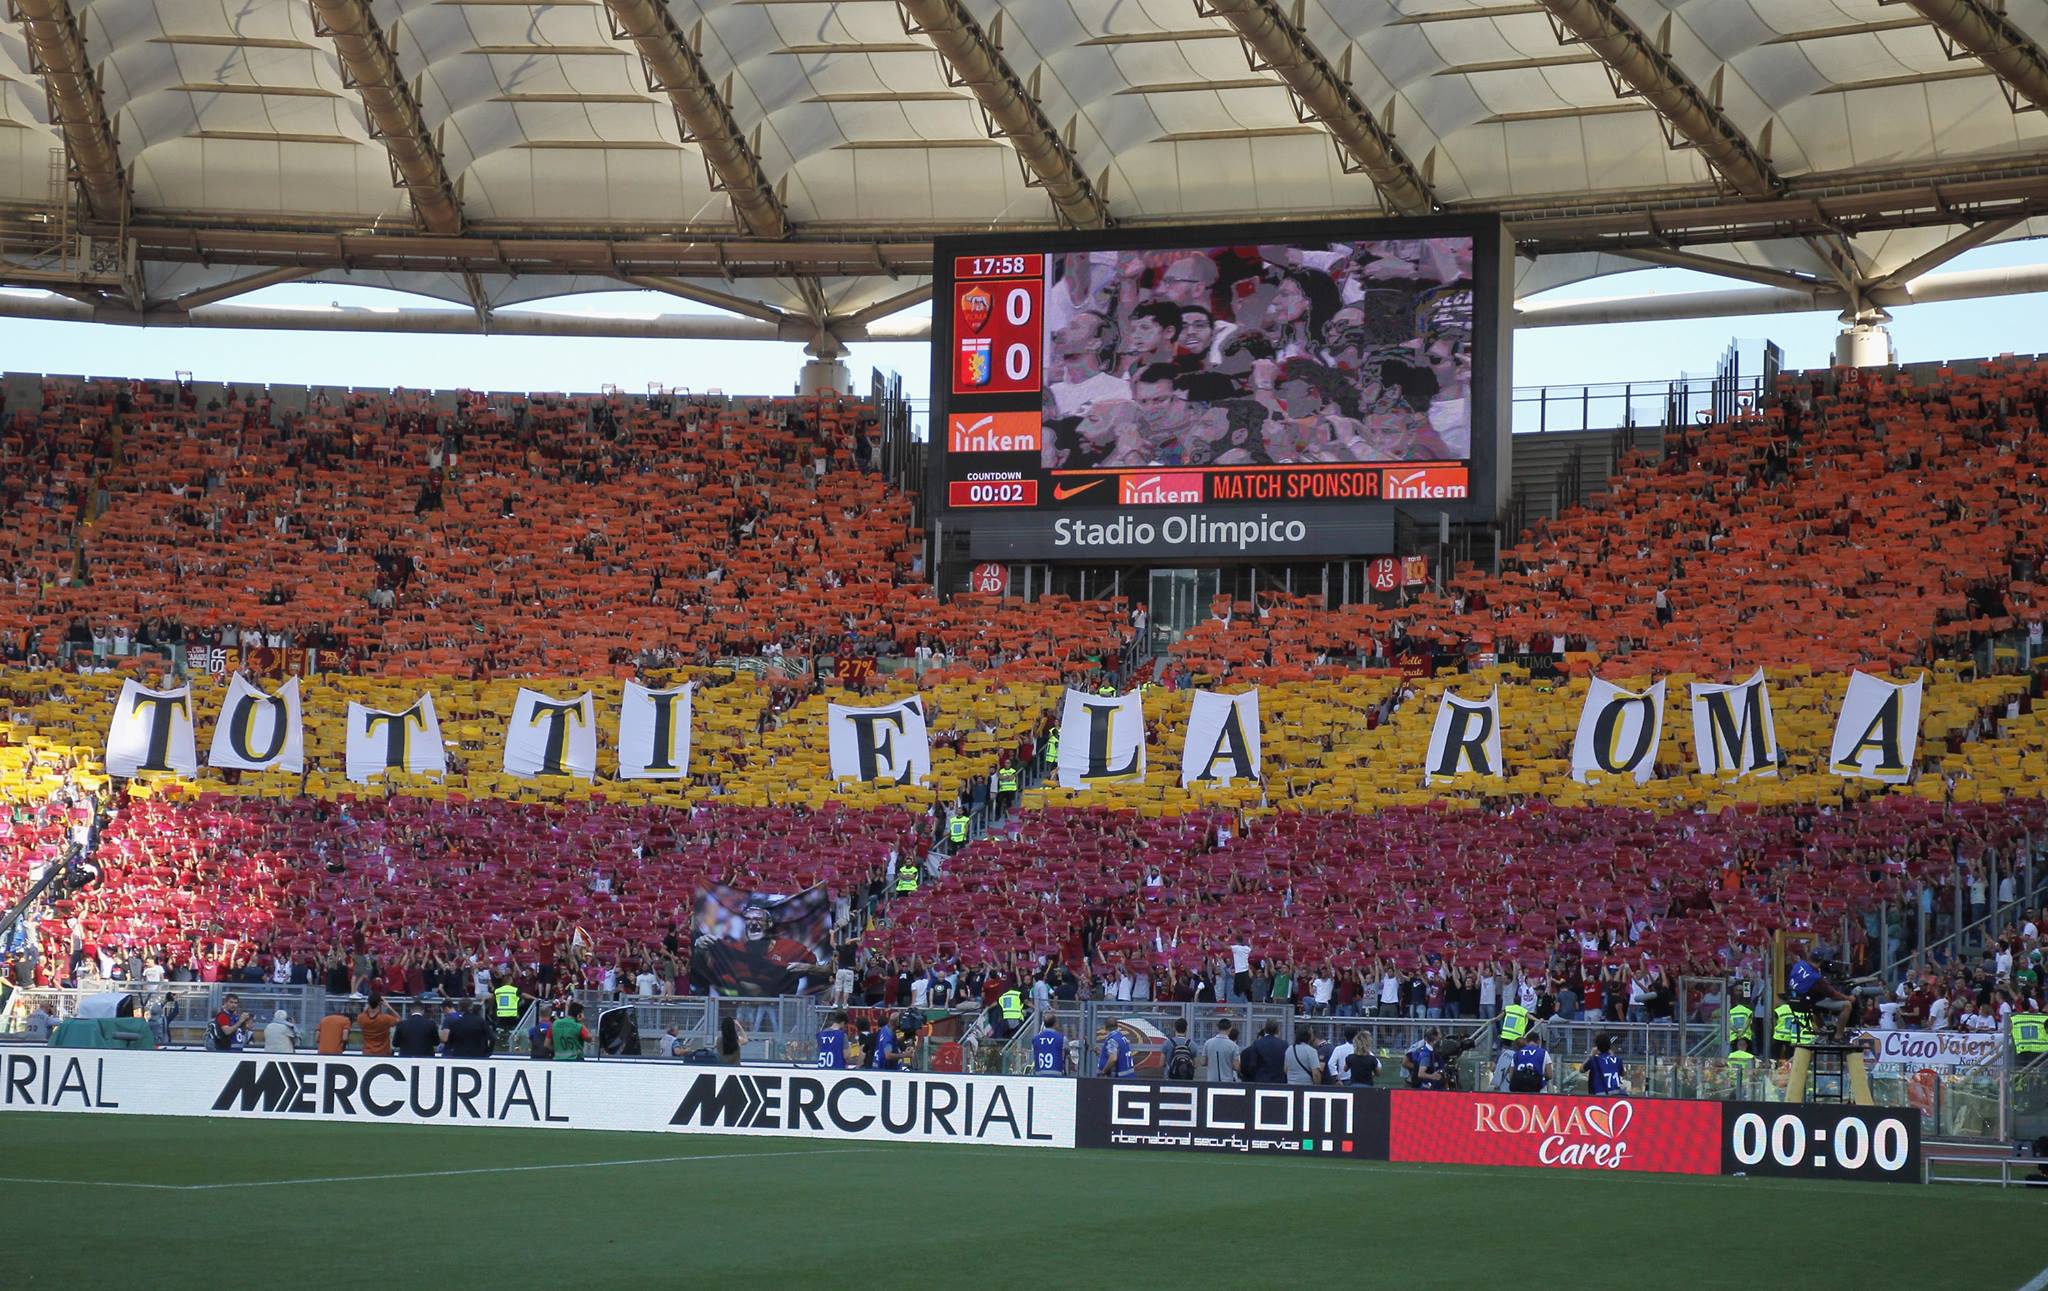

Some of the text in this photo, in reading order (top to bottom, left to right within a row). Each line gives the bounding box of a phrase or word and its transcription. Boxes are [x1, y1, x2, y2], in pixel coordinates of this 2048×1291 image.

[973, 256, 1025, 275] 17:58
[1006, 287, 1032, 326] 0
[1005, 342, 1031, 380] 0
[967, 472, 1022, 480] COUNTDOWN
[1213, 472, 1378, 499] MATCH SPONSOR
[970, 485, 1023, 502] 00:02
[1054, 513, 1306, 550] Stadio Olimpico
[982, 563, 1000, 577] 20
[1377, 559, 1393, 573] 19
[980, 577, 1002, 592] AD
[1375, 574, 1394, 588] AS
[839, 660, 875, 678] 27%
[1430, 680, 1908, 776] ROMA
[821, 1036, 835, 1044] TV
[1040, 1037, 1055, 1045] TV
[1885, 1032, 1937, 1058] Ciao
[818, 1051, 834, 1068] 50
[0, 1054, 119, 1109] RIAL
[211, 1060, 570, 1123] MERCURIAL
[668, 1072, 1054, 1141] MERCURIAL
[1474, 1102, 1592, 1136] ROMA
[1111, 1130, 1300, 1152] international security service
[1538, 1135, 1633, 1169] Cares
[1732, 1112, 1909, 1171] 00:00
